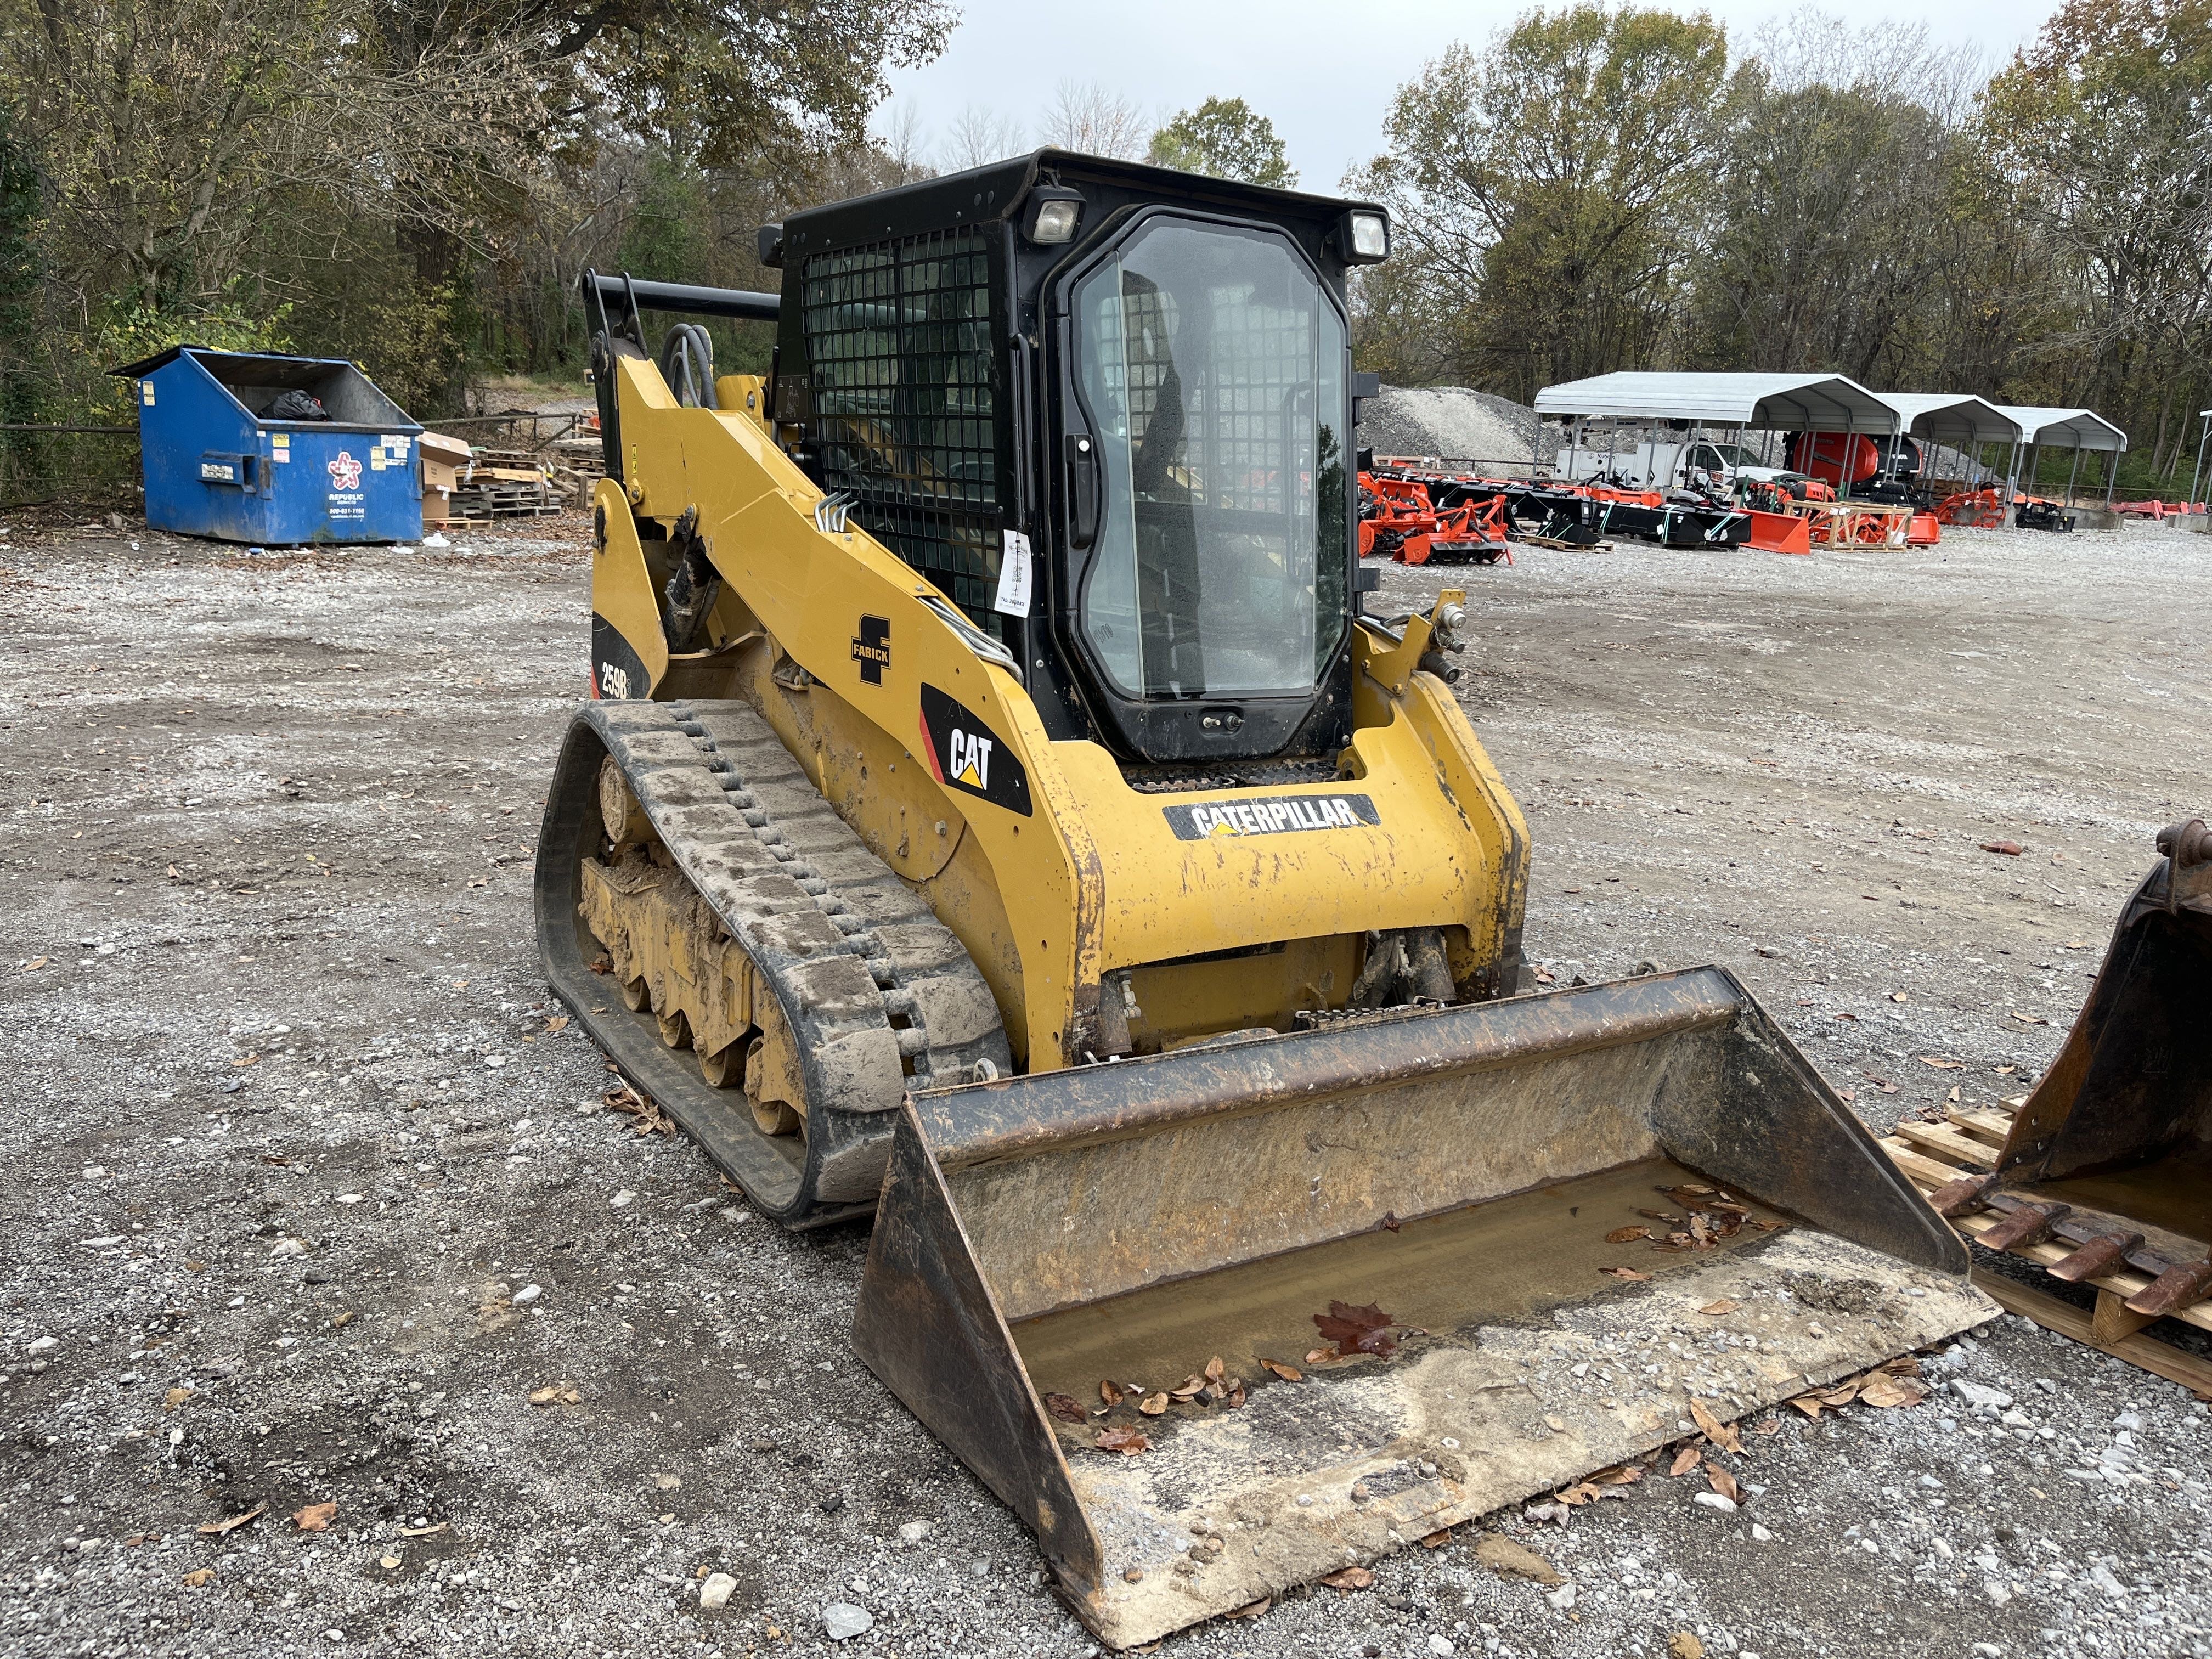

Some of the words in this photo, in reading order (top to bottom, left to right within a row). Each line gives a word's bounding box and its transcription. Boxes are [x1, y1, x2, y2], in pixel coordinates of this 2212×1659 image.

[854, 643, 889, 663] FABICK
[950, 728, 992, 791] CAT
[1190, 798, 1359, 837] CATERPILLAR
